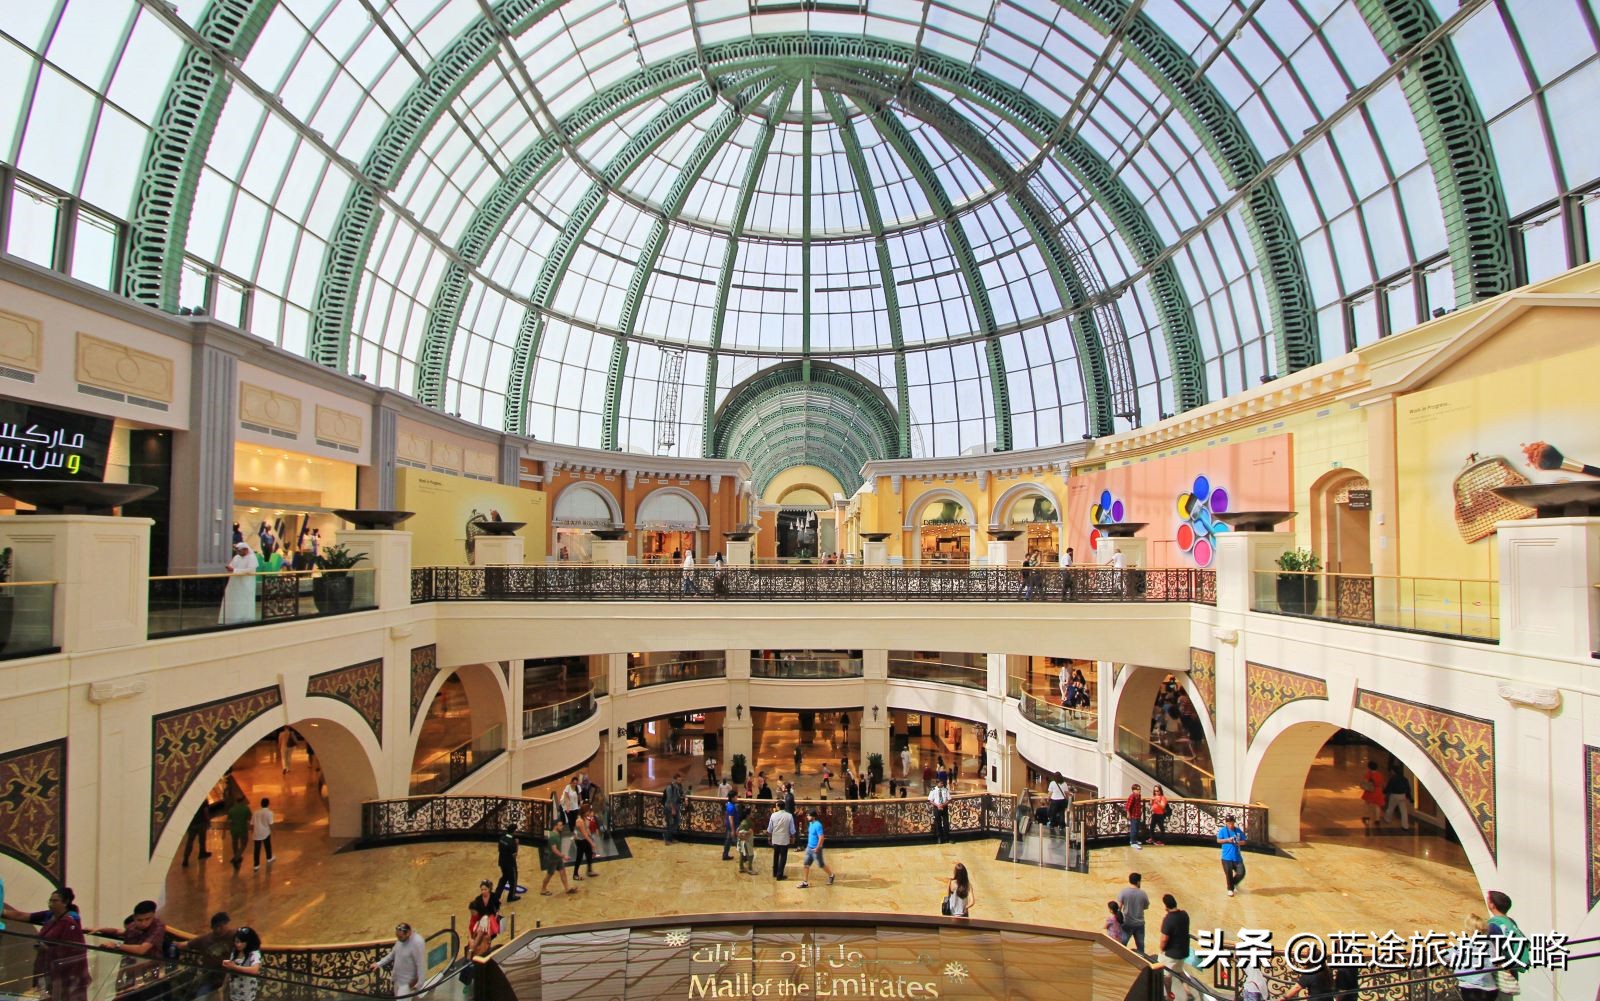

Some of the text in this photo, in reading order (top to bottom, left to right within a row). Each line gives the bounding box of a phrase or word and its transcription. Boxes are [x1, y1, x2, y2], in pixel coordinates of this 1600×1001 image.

[688, 973, 939, 1000] Mall of the Emirates
